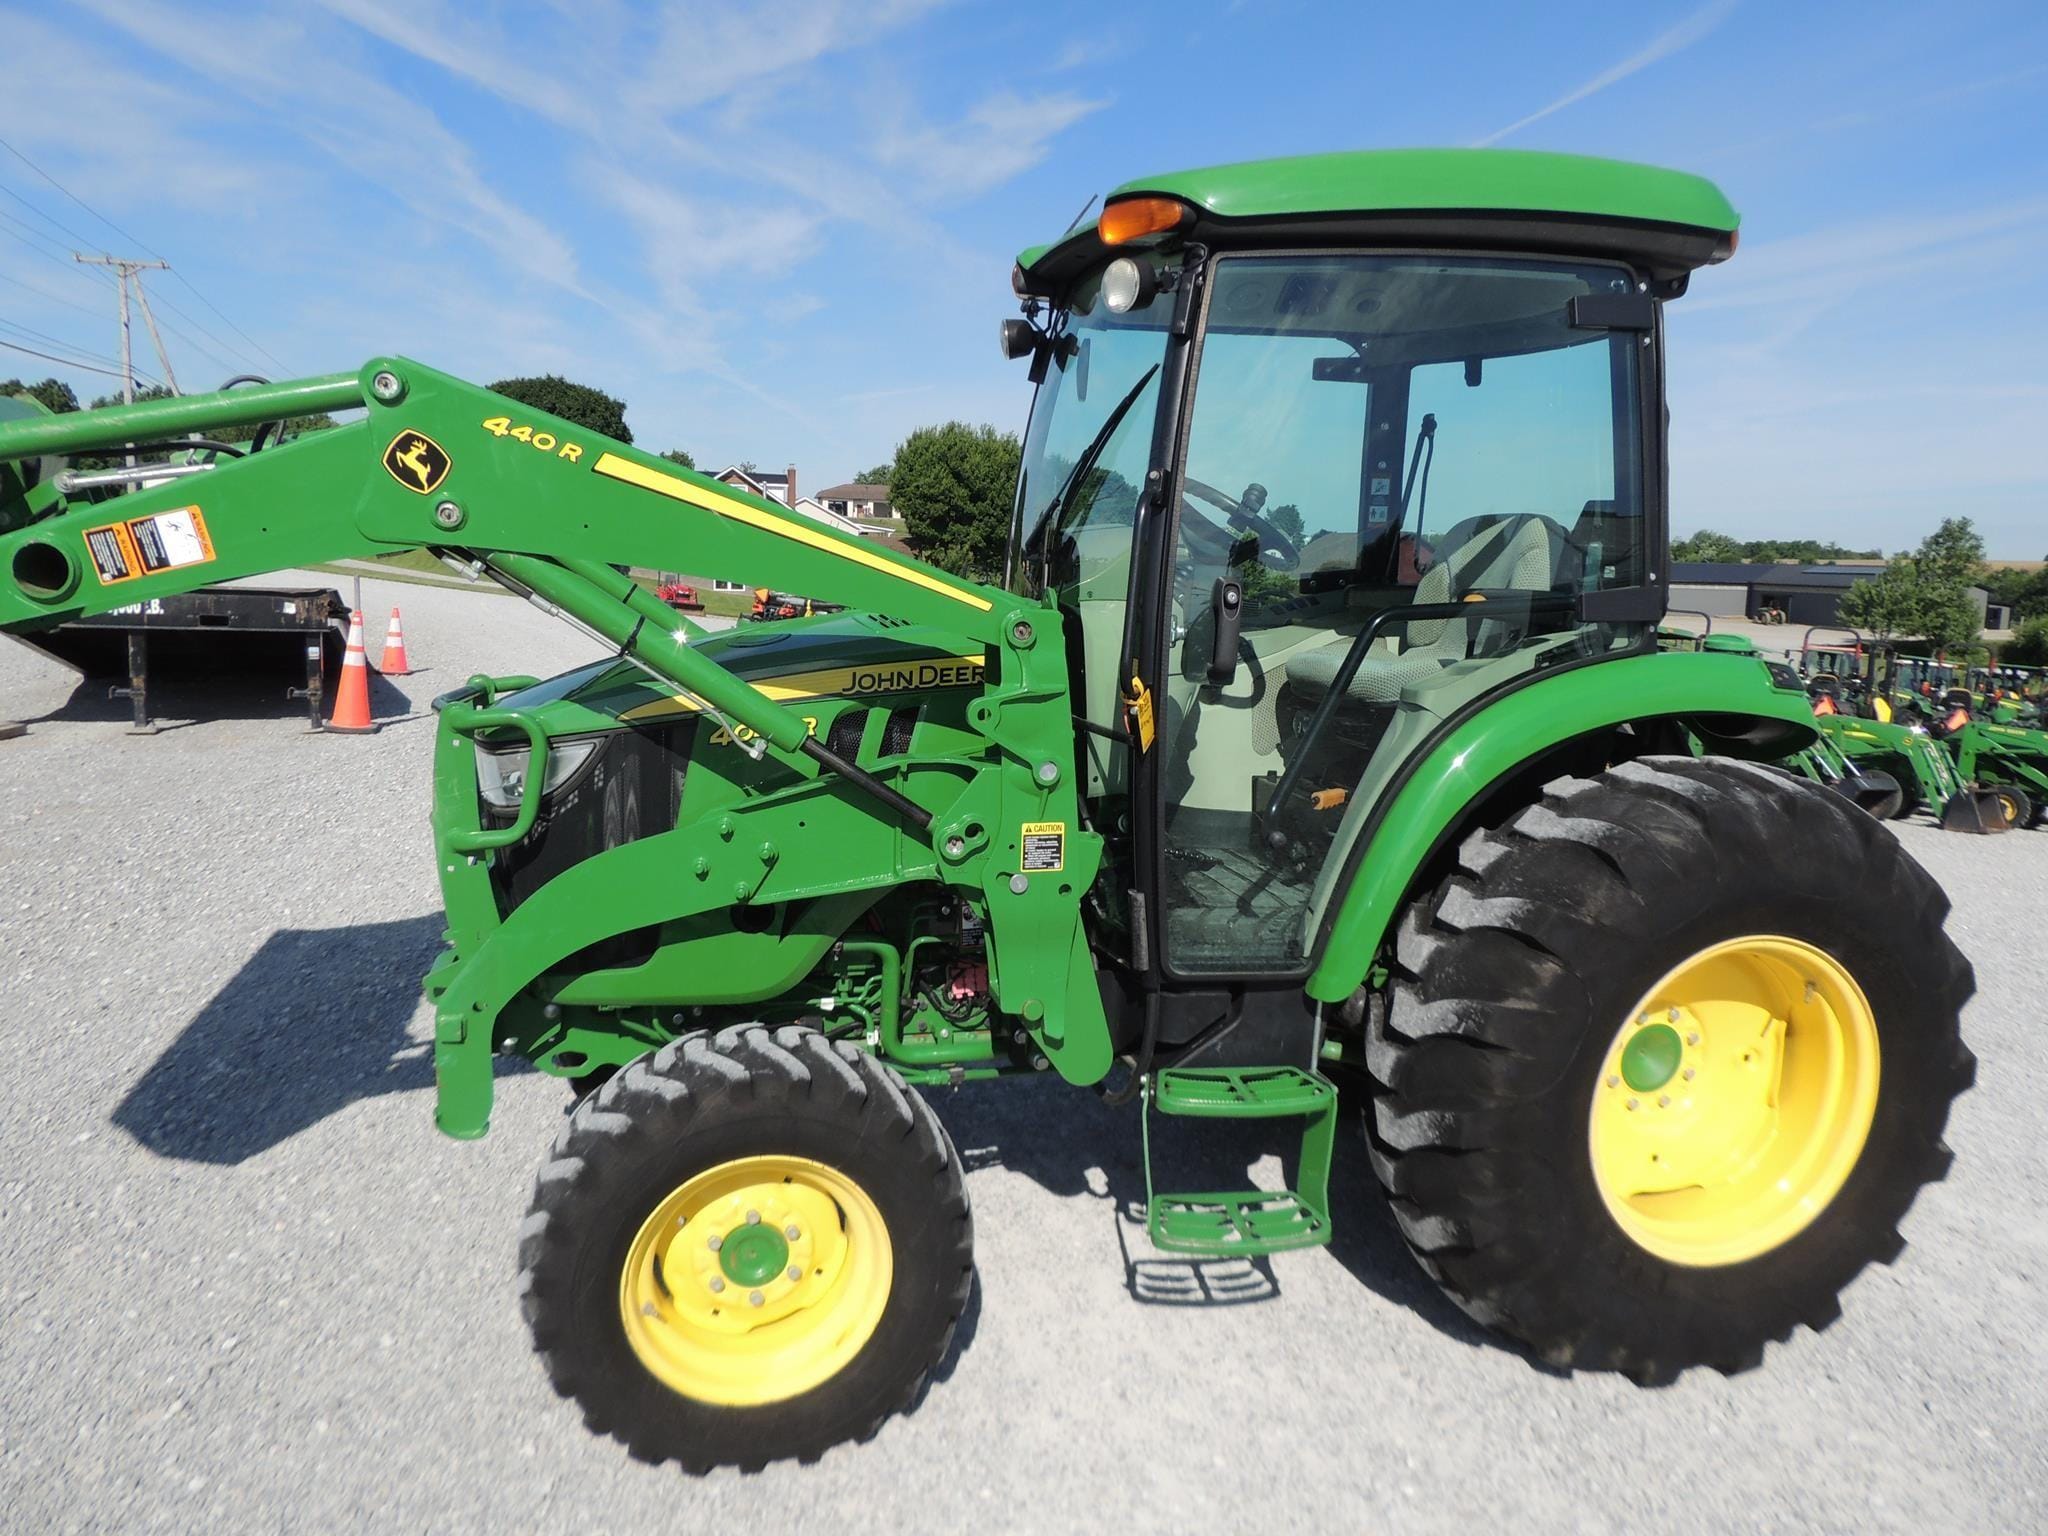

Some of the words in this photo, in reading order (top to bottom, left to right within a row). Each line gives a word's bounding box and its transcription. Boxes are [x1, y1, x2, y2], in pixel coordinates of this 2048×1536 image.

[841, 670, 914, 694] JOHN
[918, 664, 985, 687] DEER
[1033, 824, 1063, 833] CAUTION
